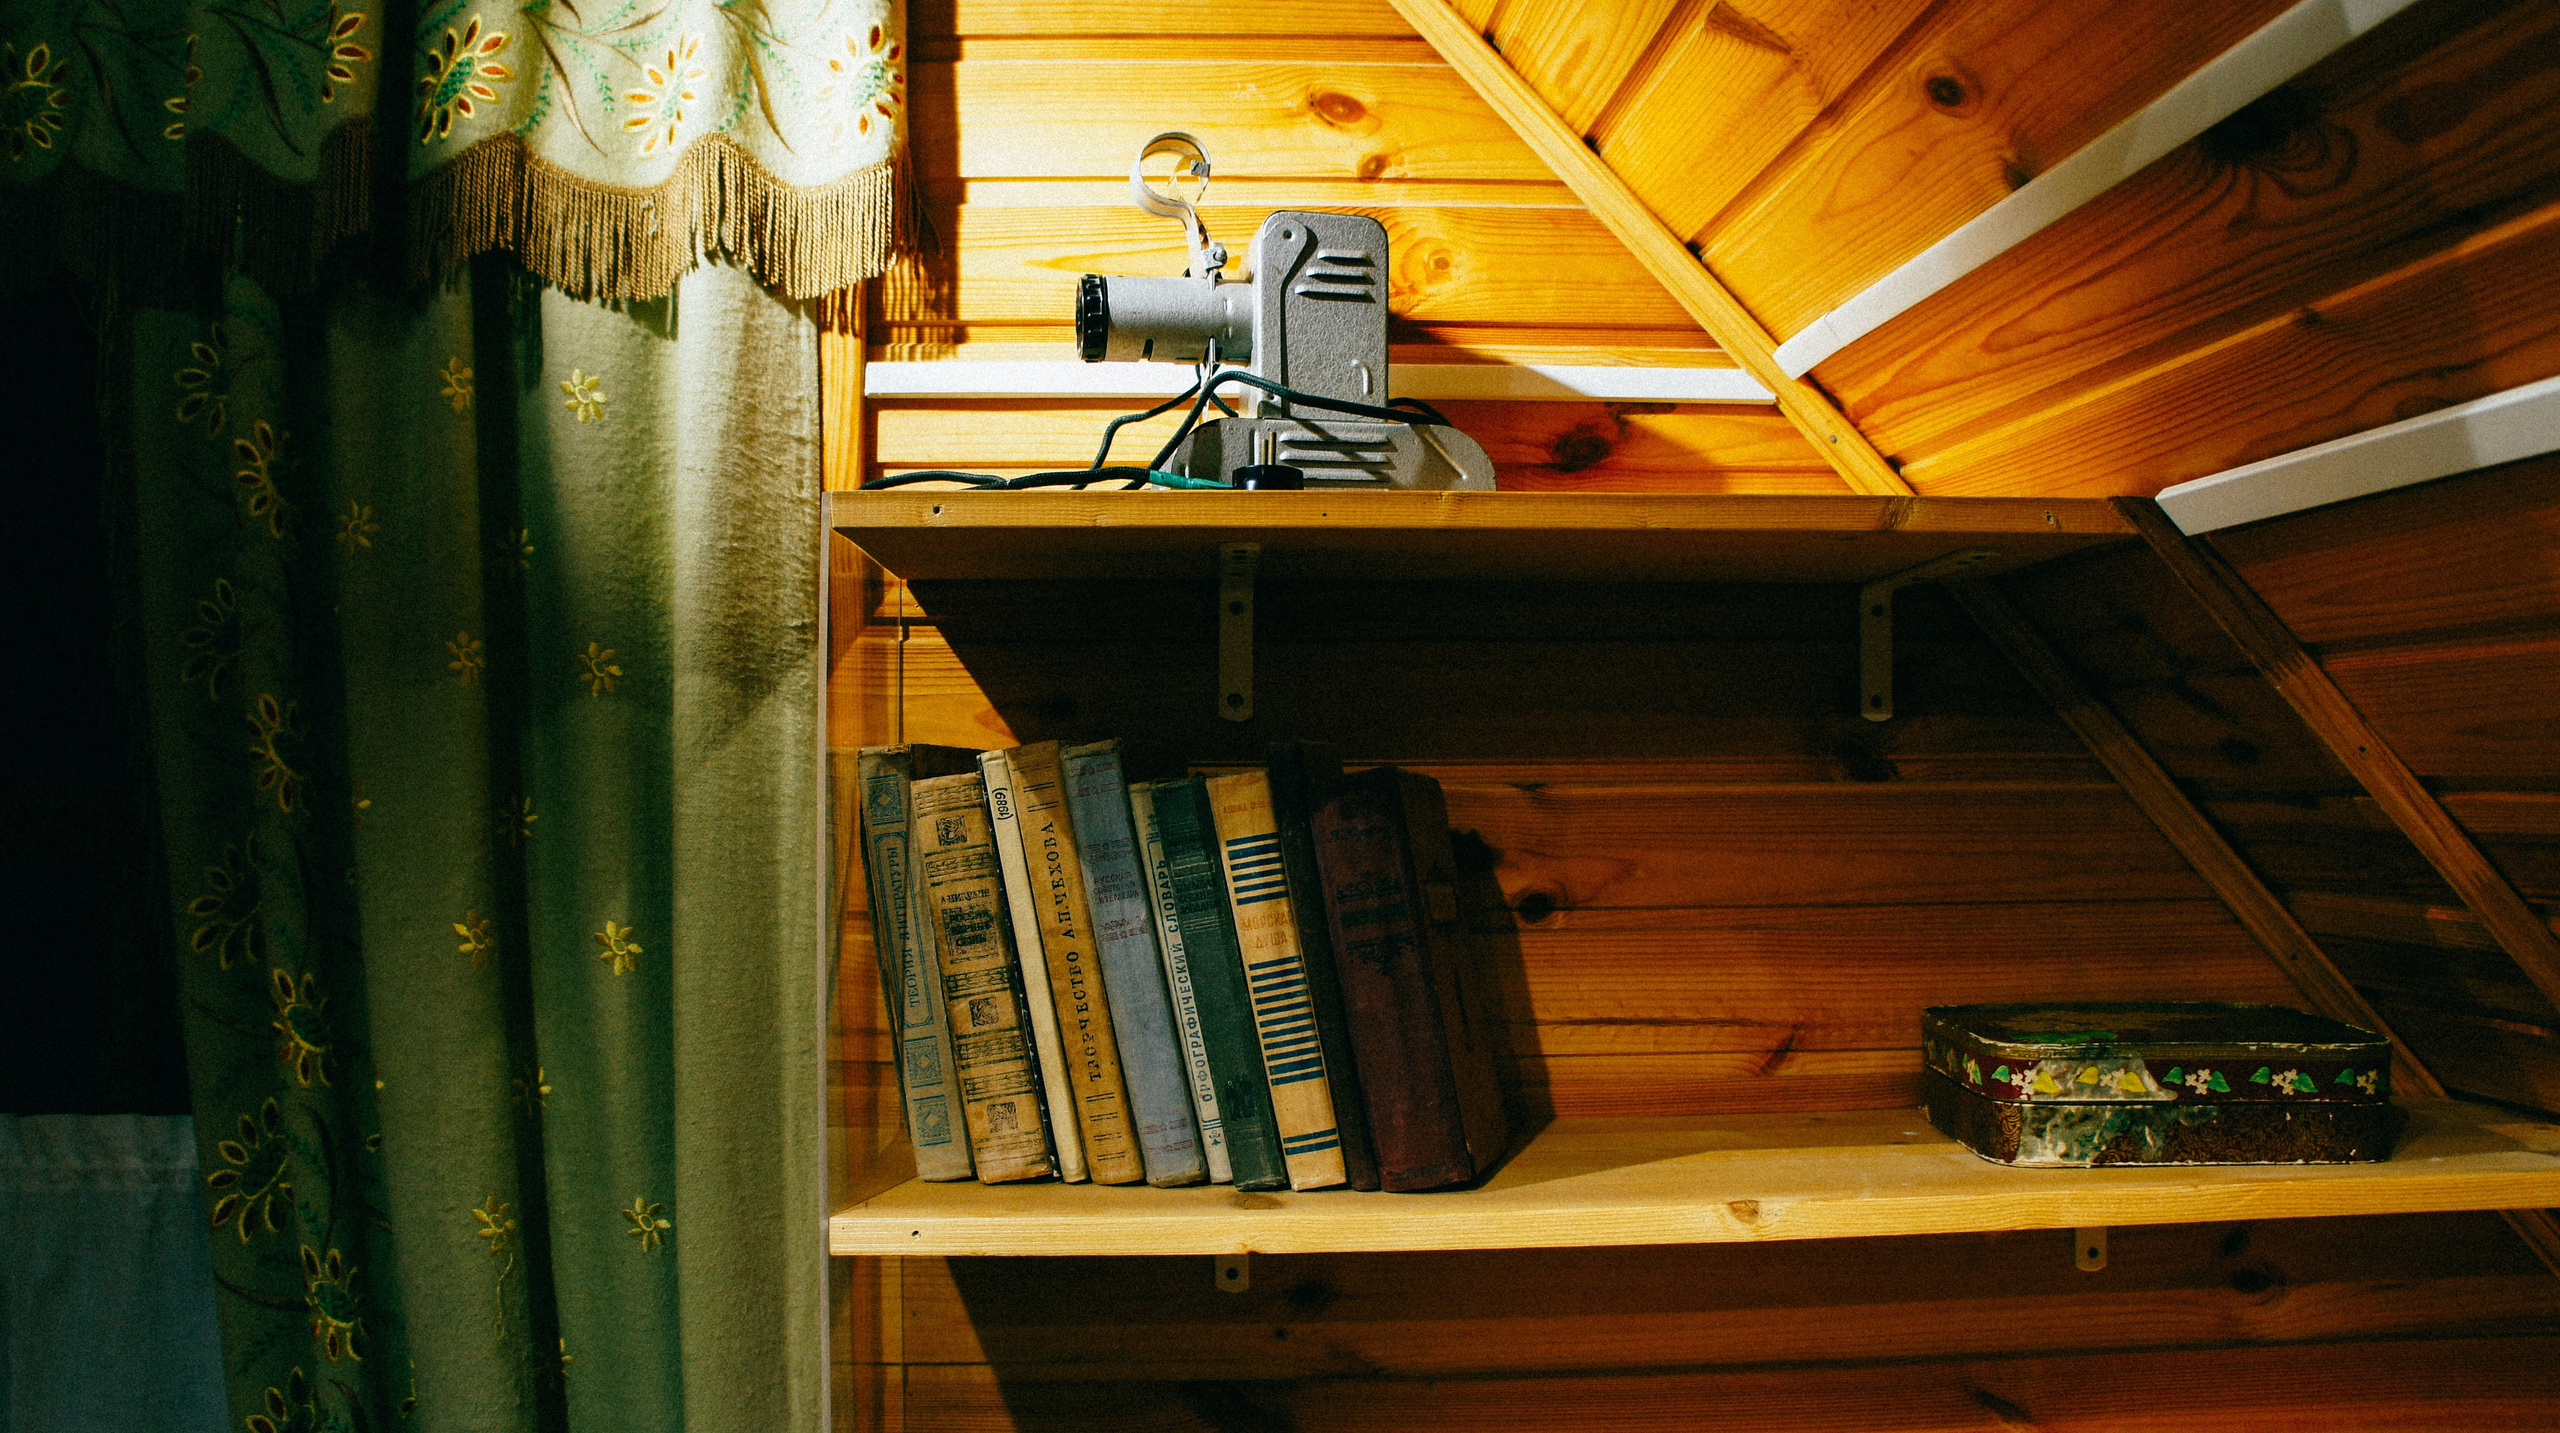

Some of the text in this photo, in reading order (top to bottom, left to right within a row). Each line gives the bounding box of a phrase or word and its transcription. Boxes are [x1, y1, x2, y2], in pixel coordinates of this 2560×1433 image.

[992, 787, 1014, 820] (1989)
[886, 846, 920, 1008] ТЕОРИЯ ЛИТЕРАТУРЫ
[1156, 859, 1179, 933] СЛОВАРЬ
[1241, 911, 1296, 931] МОРСКАЯ
[1255, 932, 1288, 949] ДУША
[1066, 951, 1102, 1082] ТВОРЧЕСТВО
[1170, 941, 1213, 1102] ОРФОГРАФИЧЕСКИЙ
